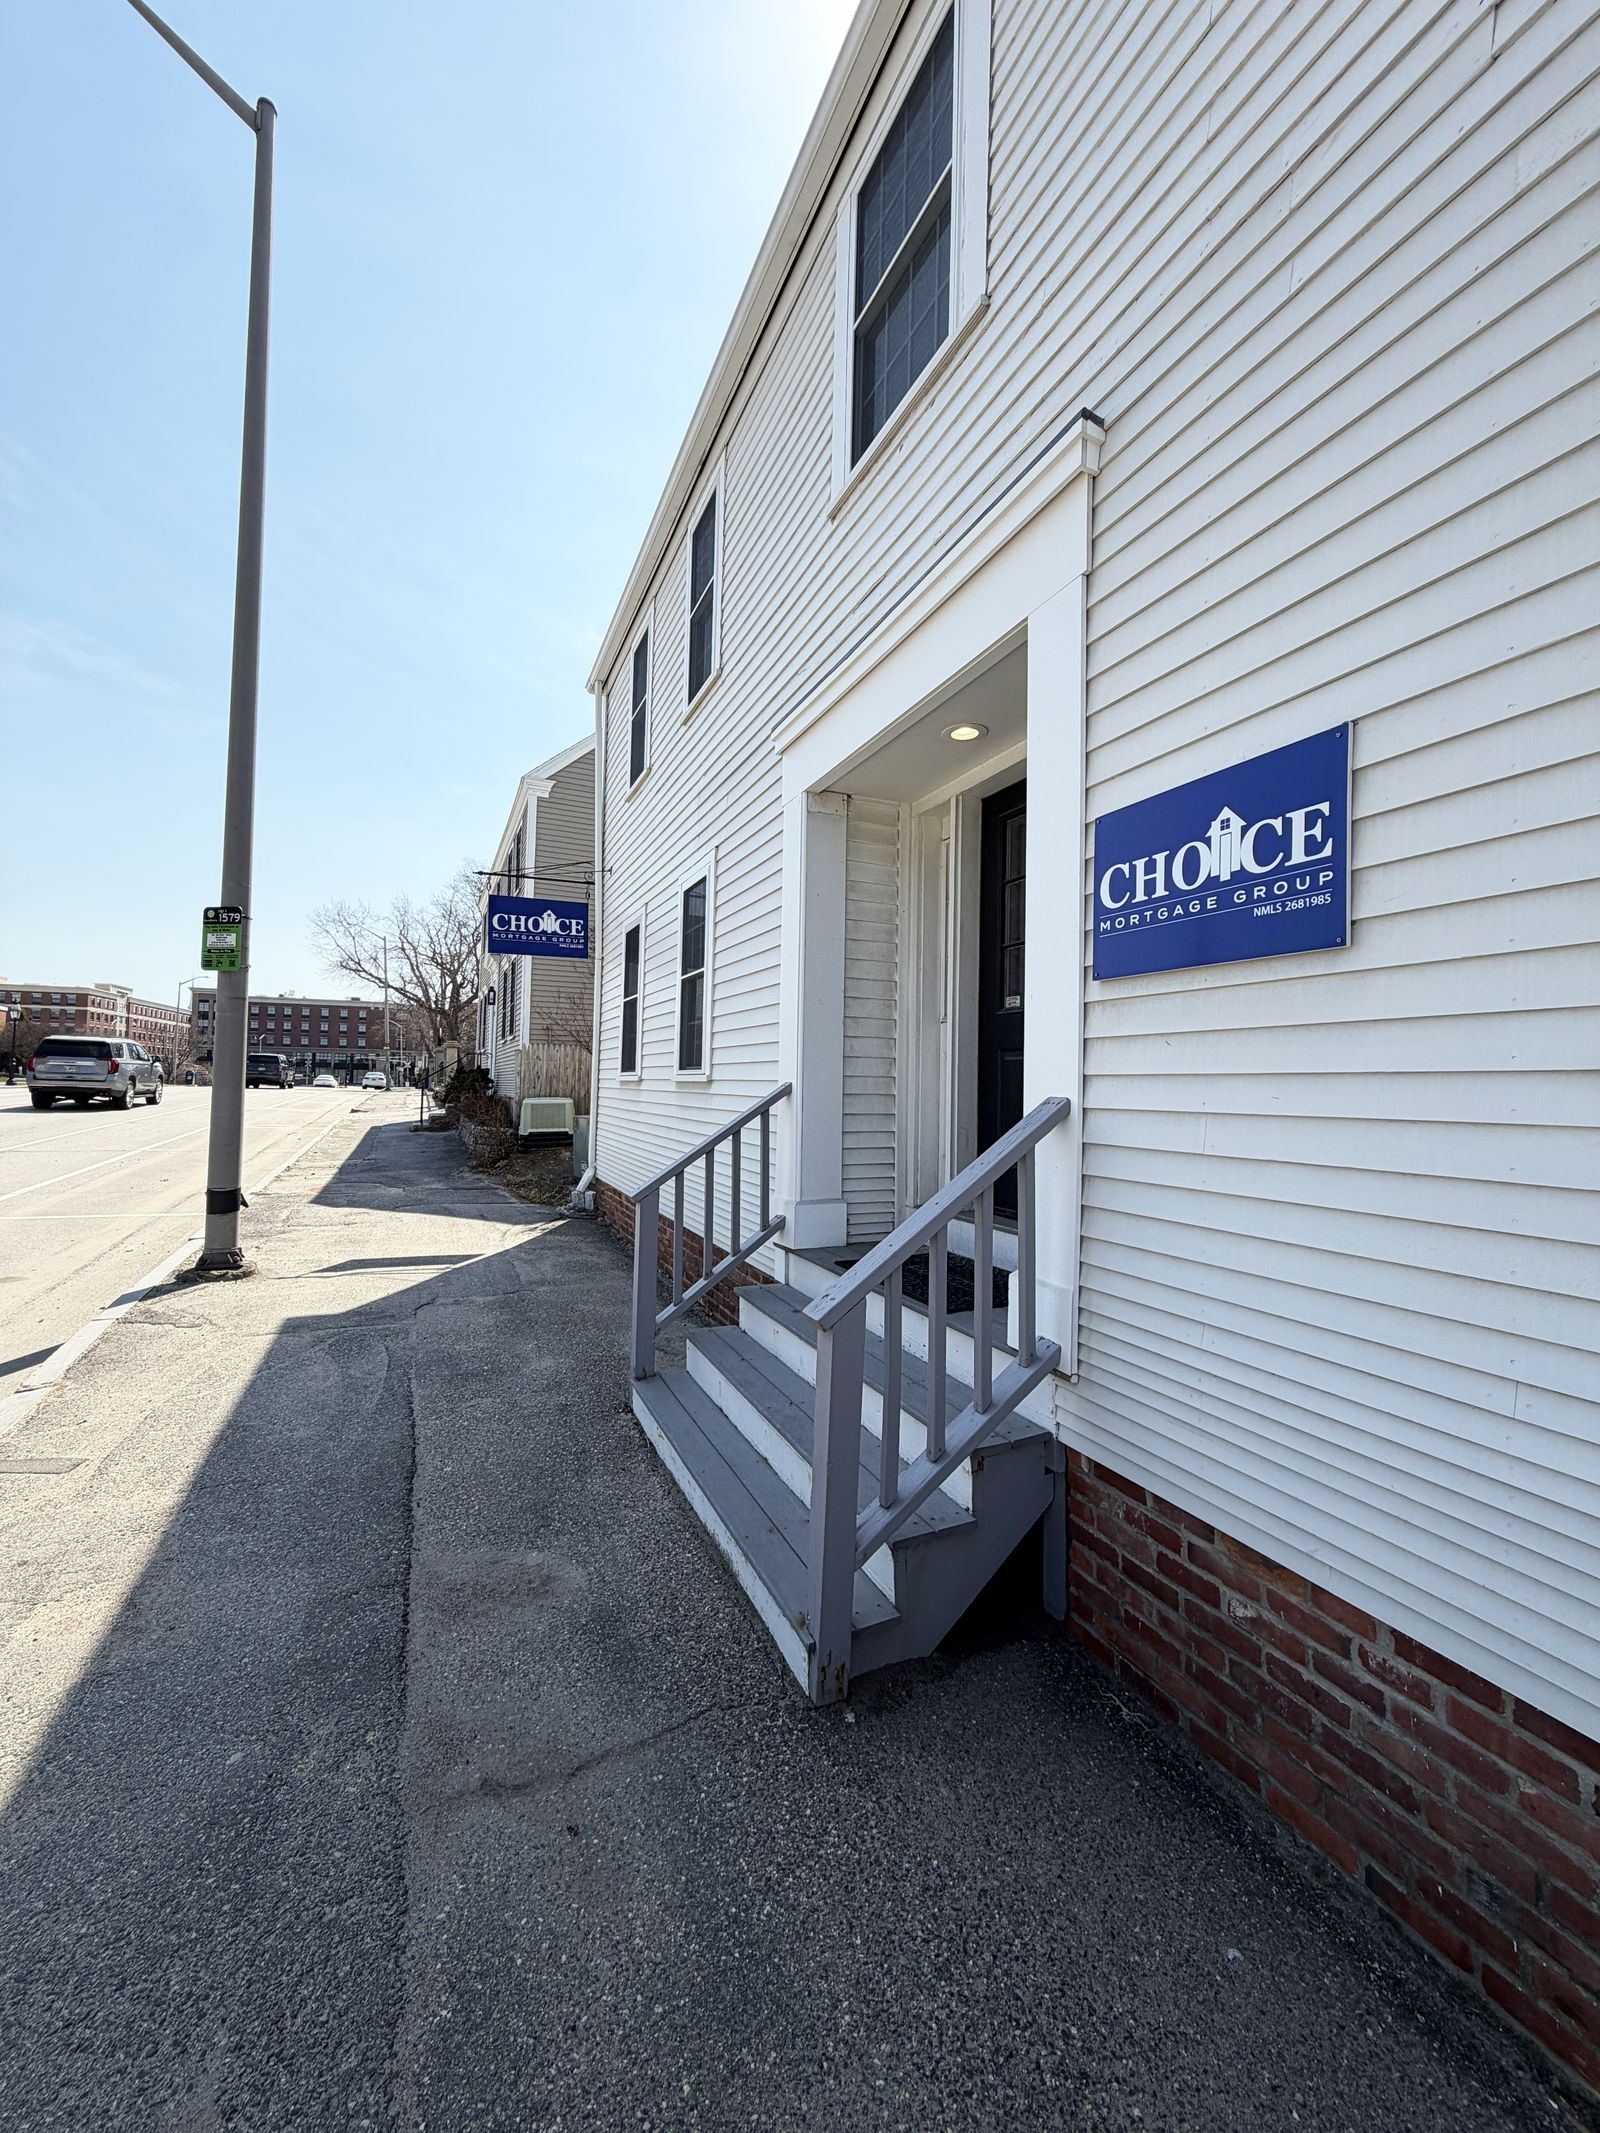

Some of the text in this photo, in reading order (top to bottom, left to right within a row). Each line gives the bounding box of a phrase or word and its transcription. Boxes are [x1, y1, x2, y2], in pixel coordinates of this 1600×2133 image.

[1099, 800, 1333, 909] CHOICE
[1100, 870, 1334, 932] MORTGAGE GROUP
[1253, 893, 1332, 917] NMLS 2681985
[219, 913, 240, 922] 1579
[492, 909, 584, 936] CHOICE
[492, 933, 547, 941] MORTGAGE
